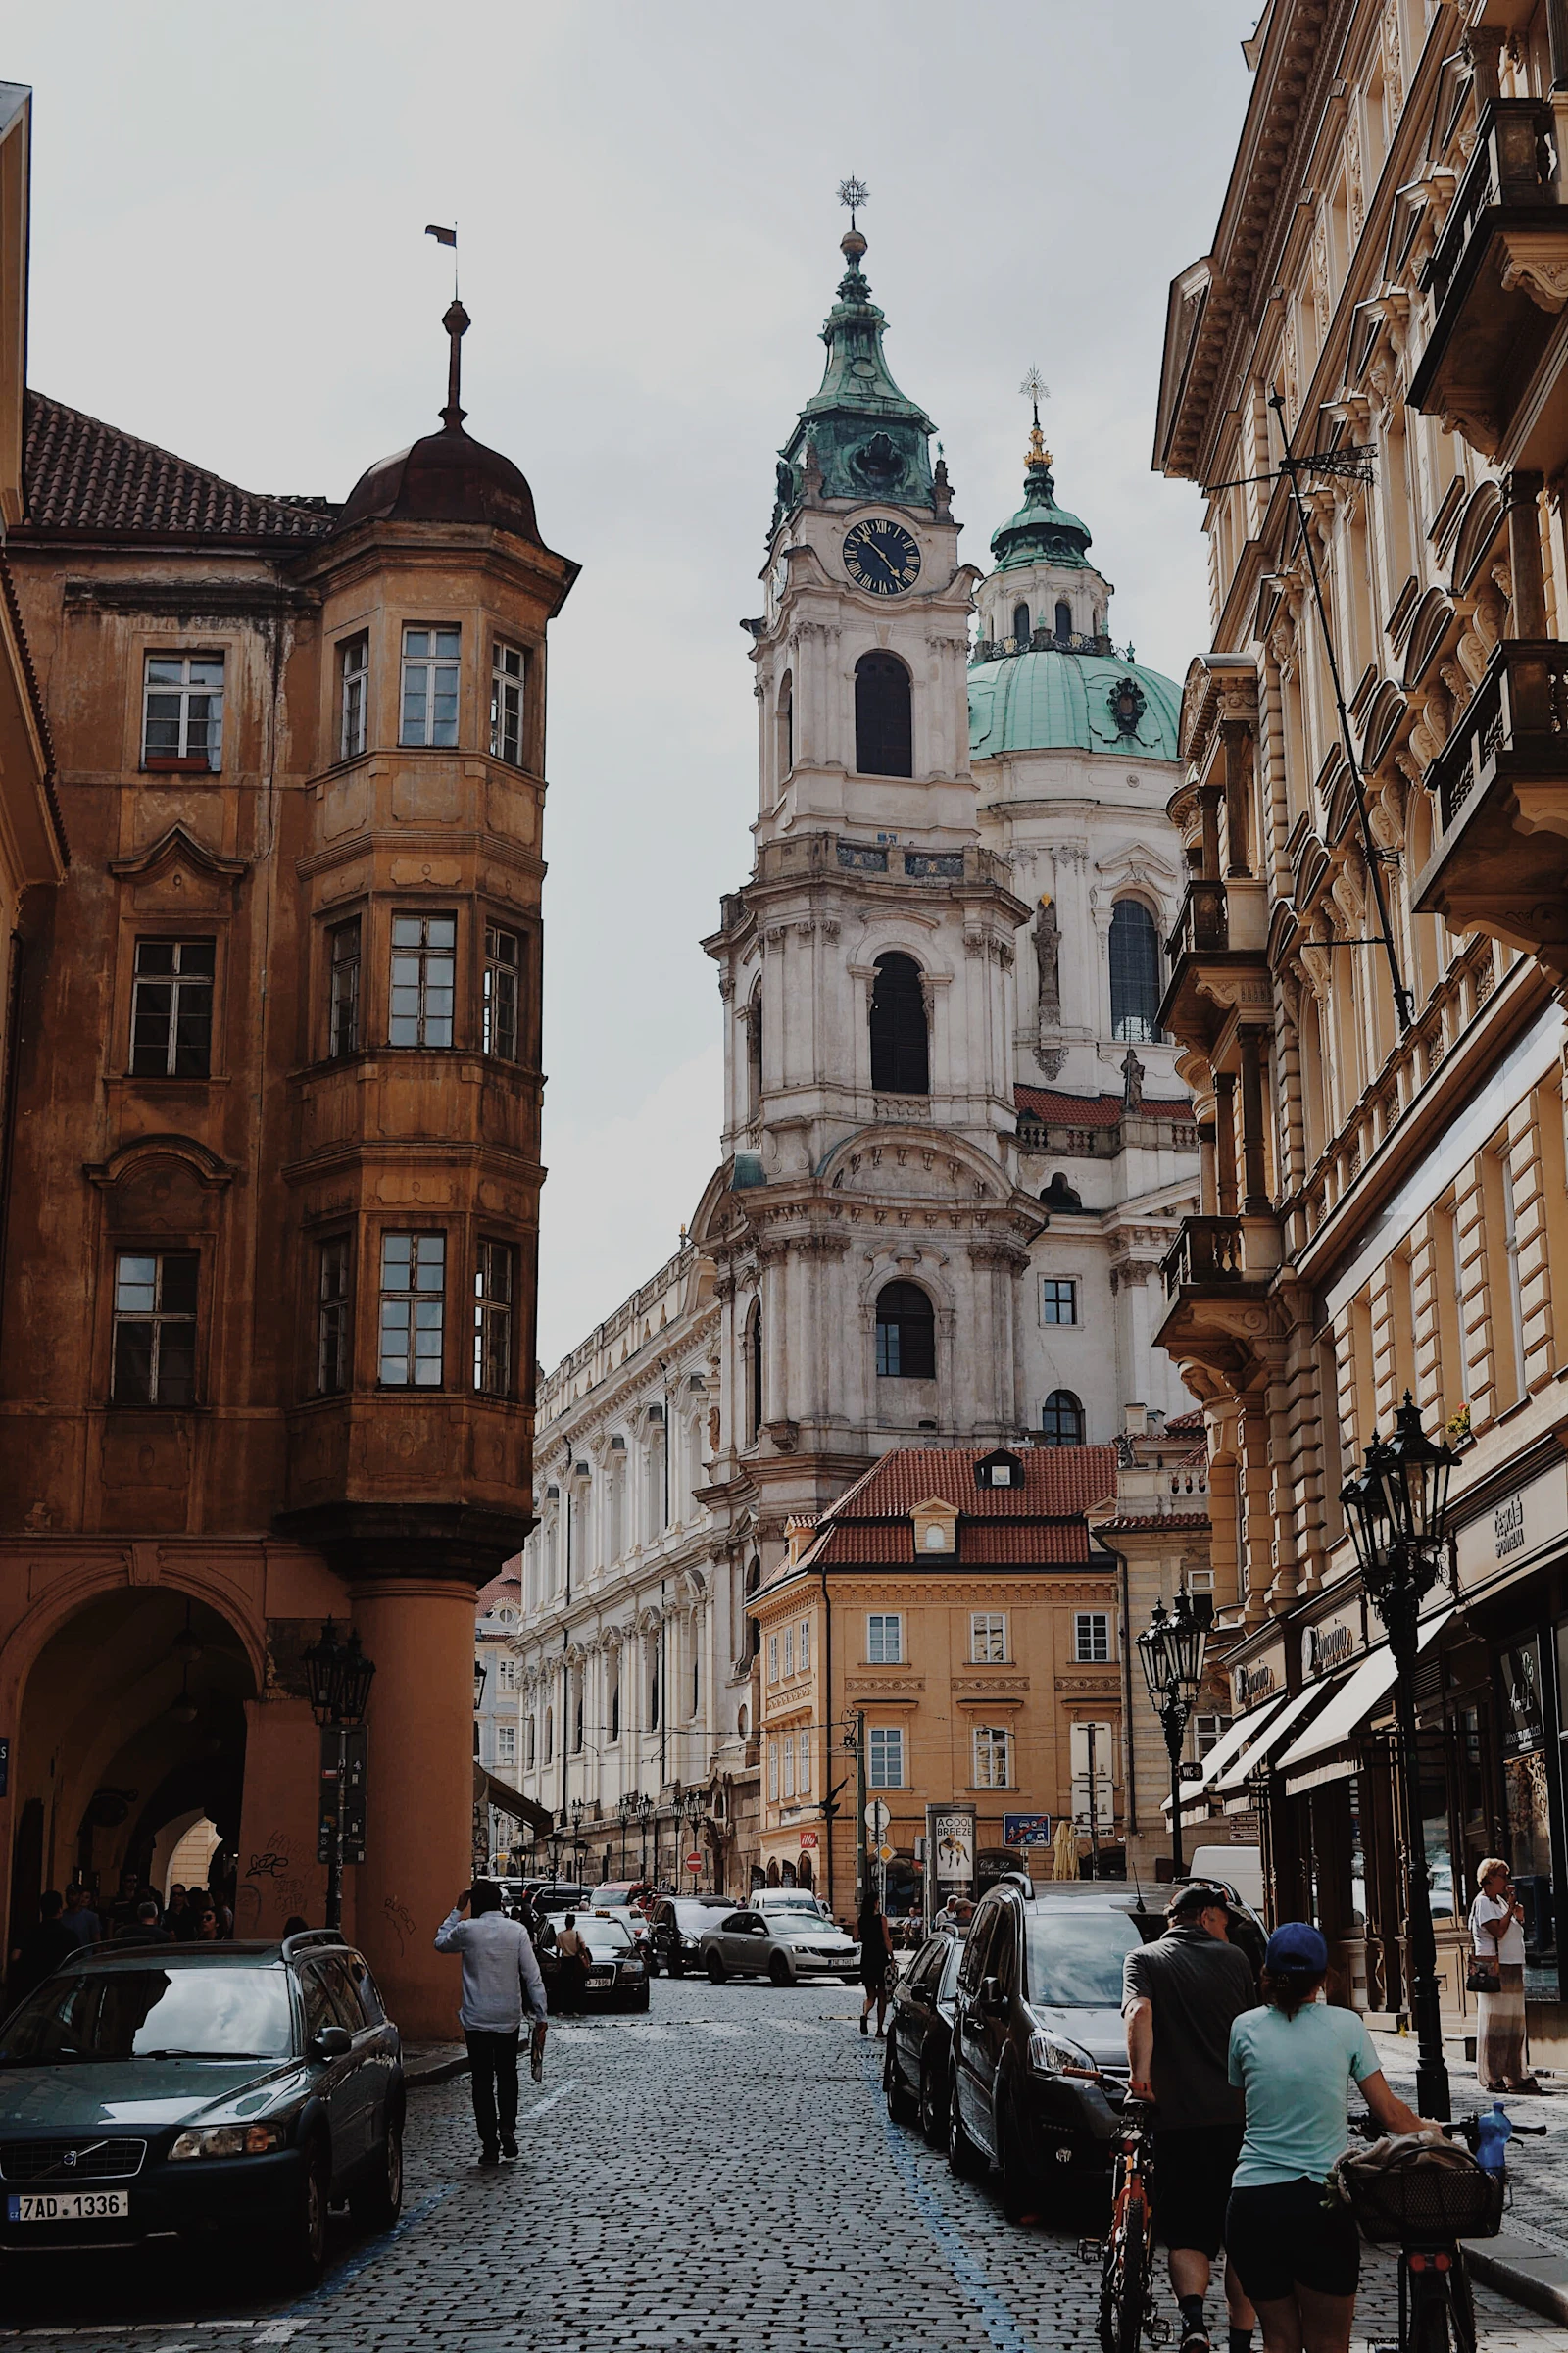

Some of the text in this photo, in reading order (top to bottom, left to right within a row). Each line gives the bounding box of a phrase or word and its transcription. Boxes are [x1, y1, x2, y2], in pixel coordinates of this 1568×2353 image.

[858, 522, 872, 535] XI
[875, 520, 887, 534] XII
[893, 527, 901, 538] I
[848, 533, 861, 545] X
[902, 540, 915, 549] II
[844, 549, 858, 558] IX
[906, 556, 919, 564] III
[860, 573, 872, 589] VII
[879, 580, 888, 594] VI
[895, 579, 905, 591] V
[1182, 1766, 1194, 1777] WC
[937, 1818, 971, 1827] A COOL
[937, 1827, 972, 1837] BREEZE
[801, 1834, 815, 1847] illy
[23, 2195, 120, 2218] 7AD 1336
